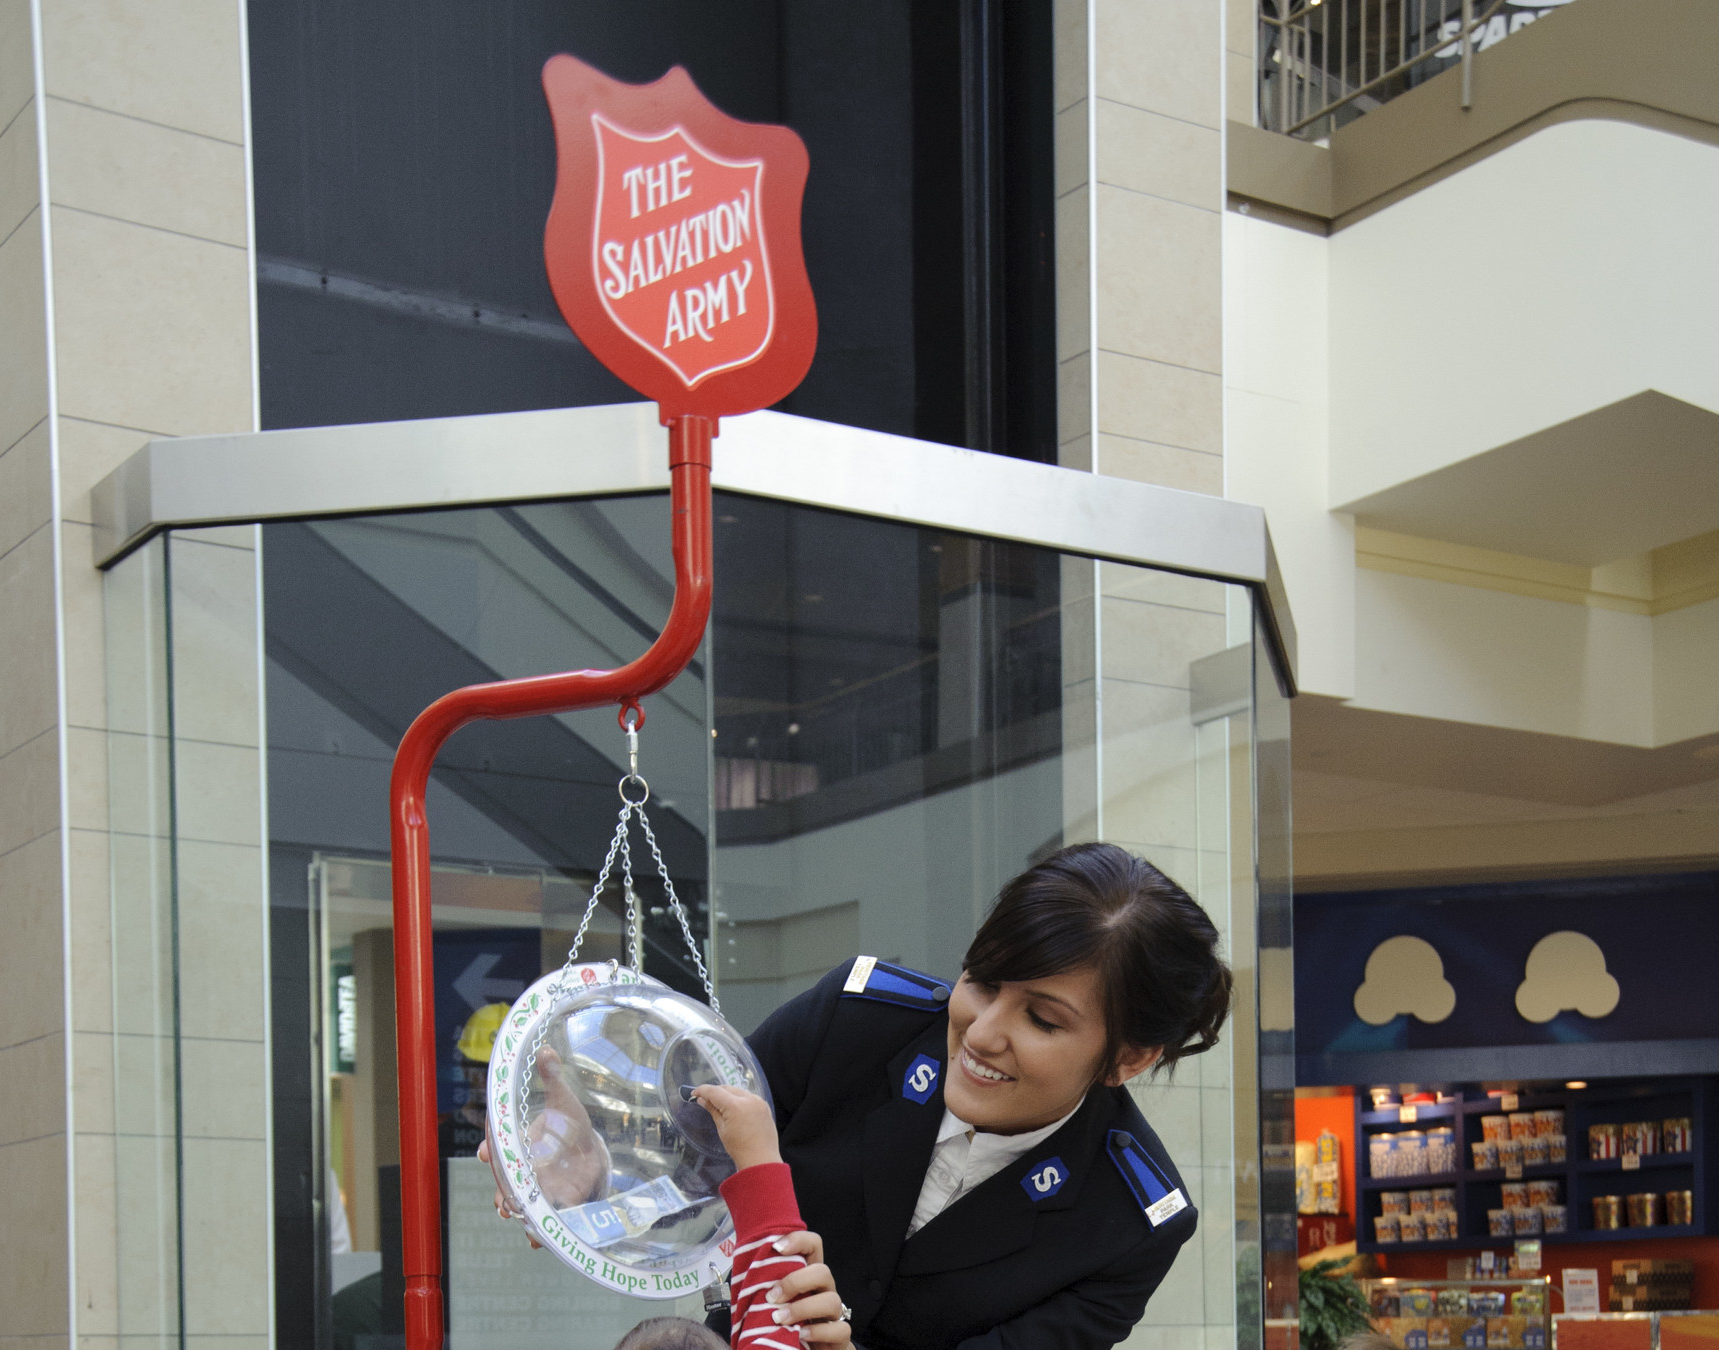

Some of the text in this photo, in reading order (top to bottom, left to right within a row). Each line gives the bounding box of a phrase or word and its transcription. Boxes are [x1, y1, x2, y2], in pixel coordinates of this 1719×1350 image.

[622, 155, 693, 219] THE
[602, 189, 751, 300] SALVATION
[663, 259, 753, 349] ARMY
[707, 1041, 737, 1086] spoir
[908, 1063, 937, 1093] S
[1031, 1166, 1061, 1193] S
[591, 1208, 612, 1229] 5
[541, 1215, 597, 1276] Giving
[601, 1261, 648, 1292] Hope
[651, 1269, 700, 1291] Today
